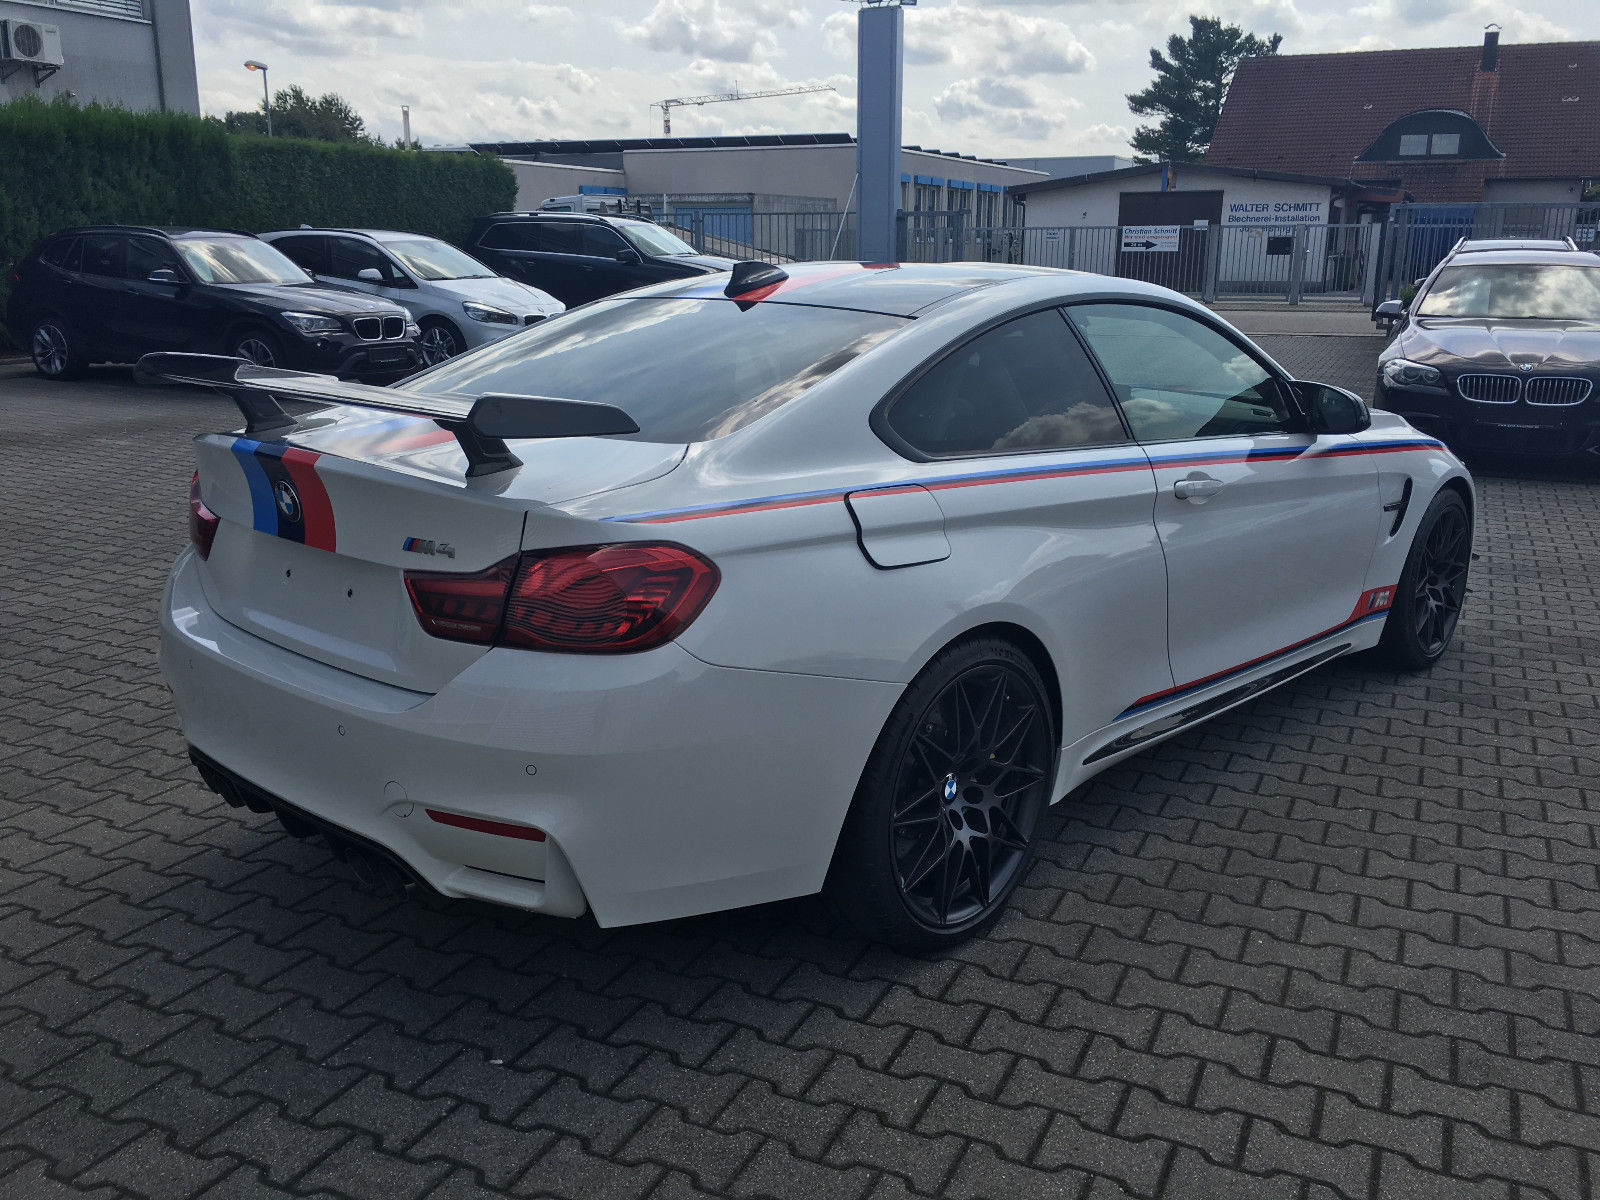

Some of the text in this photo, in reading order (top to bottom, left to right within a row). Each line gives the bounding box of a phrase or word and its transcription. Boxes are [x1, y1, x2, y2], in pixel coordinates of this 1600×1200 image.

[1229, 202, 1321, 213] WALTER SCHMITT
[1228, 214, 1320, 223] Blechnerei-Installation
[1153, 227, 1178, 235] Schmitt
